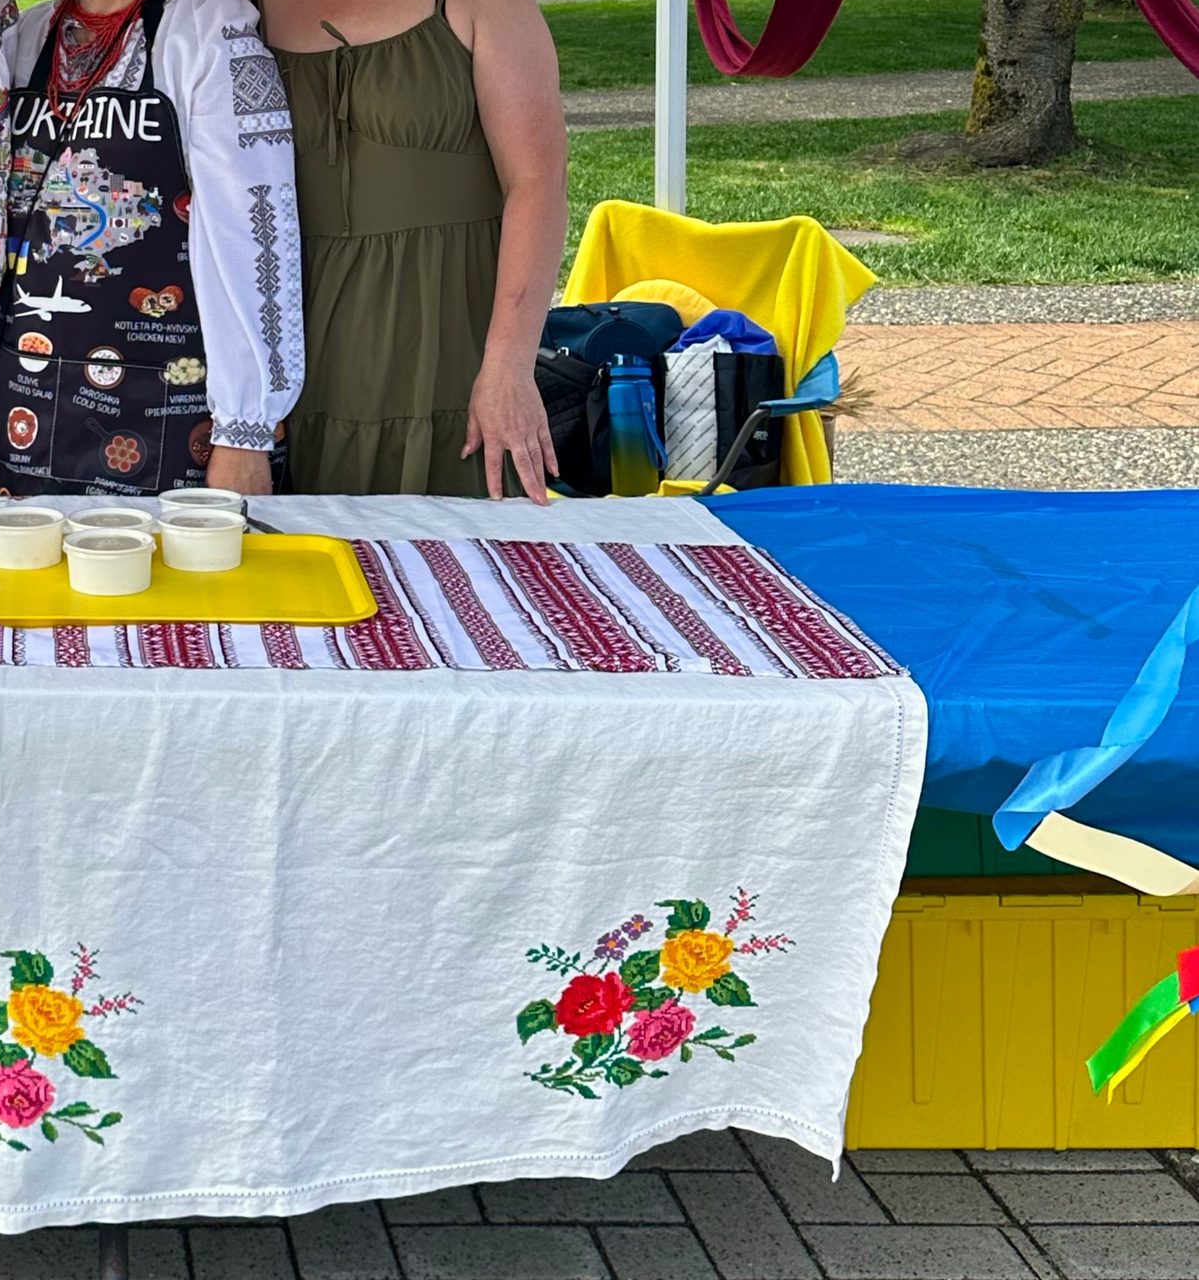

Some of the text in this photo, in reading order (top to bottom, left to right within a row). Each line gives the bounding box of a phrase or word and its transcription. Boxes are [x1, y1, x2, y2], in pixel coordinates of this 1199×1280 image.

[114, 320, 150, 331] KOTLETA
[126, 331, 164, 343] (CHICKEN
[72, 394, 121, 418] (COLD SOUP)
